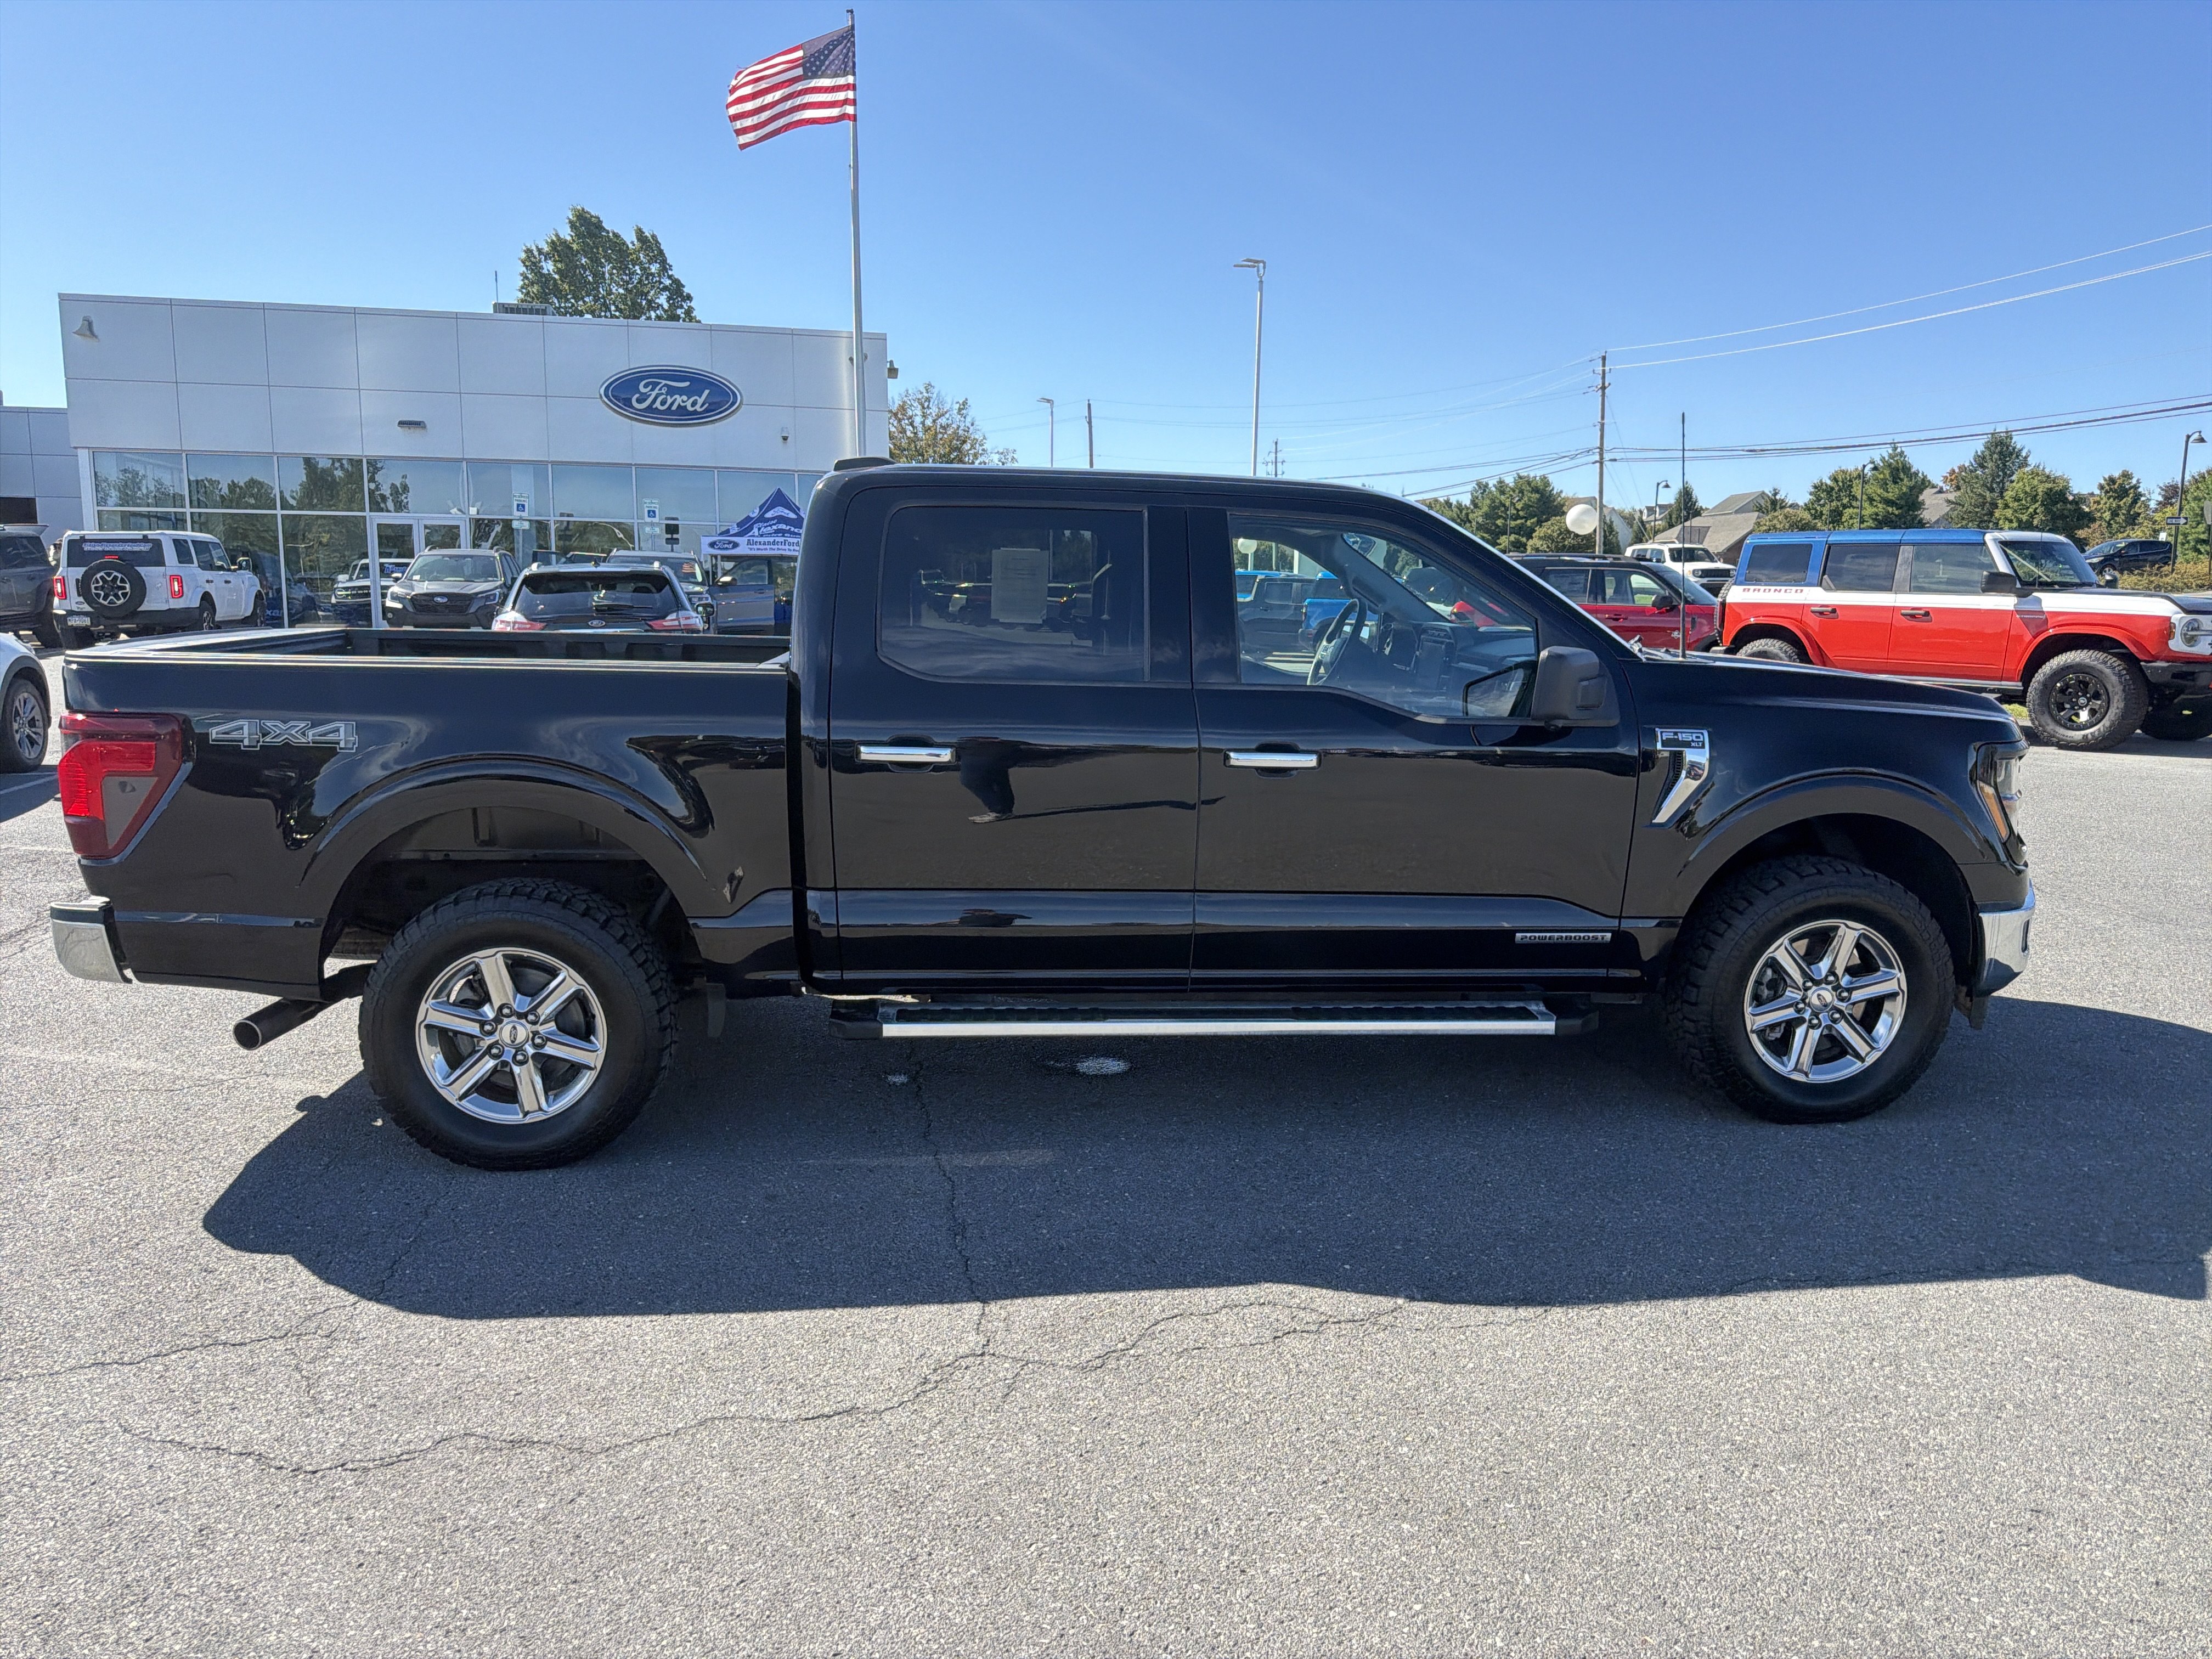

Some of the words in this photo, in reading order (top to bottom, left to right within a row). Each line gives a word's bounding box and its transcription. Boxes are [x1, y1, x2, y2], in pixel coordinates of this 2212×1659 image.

[631, 378, 710, 412] Ford
[747, 539, 799, 547] AlexanderFord
[1662, 732, 1703, 741] F-150
